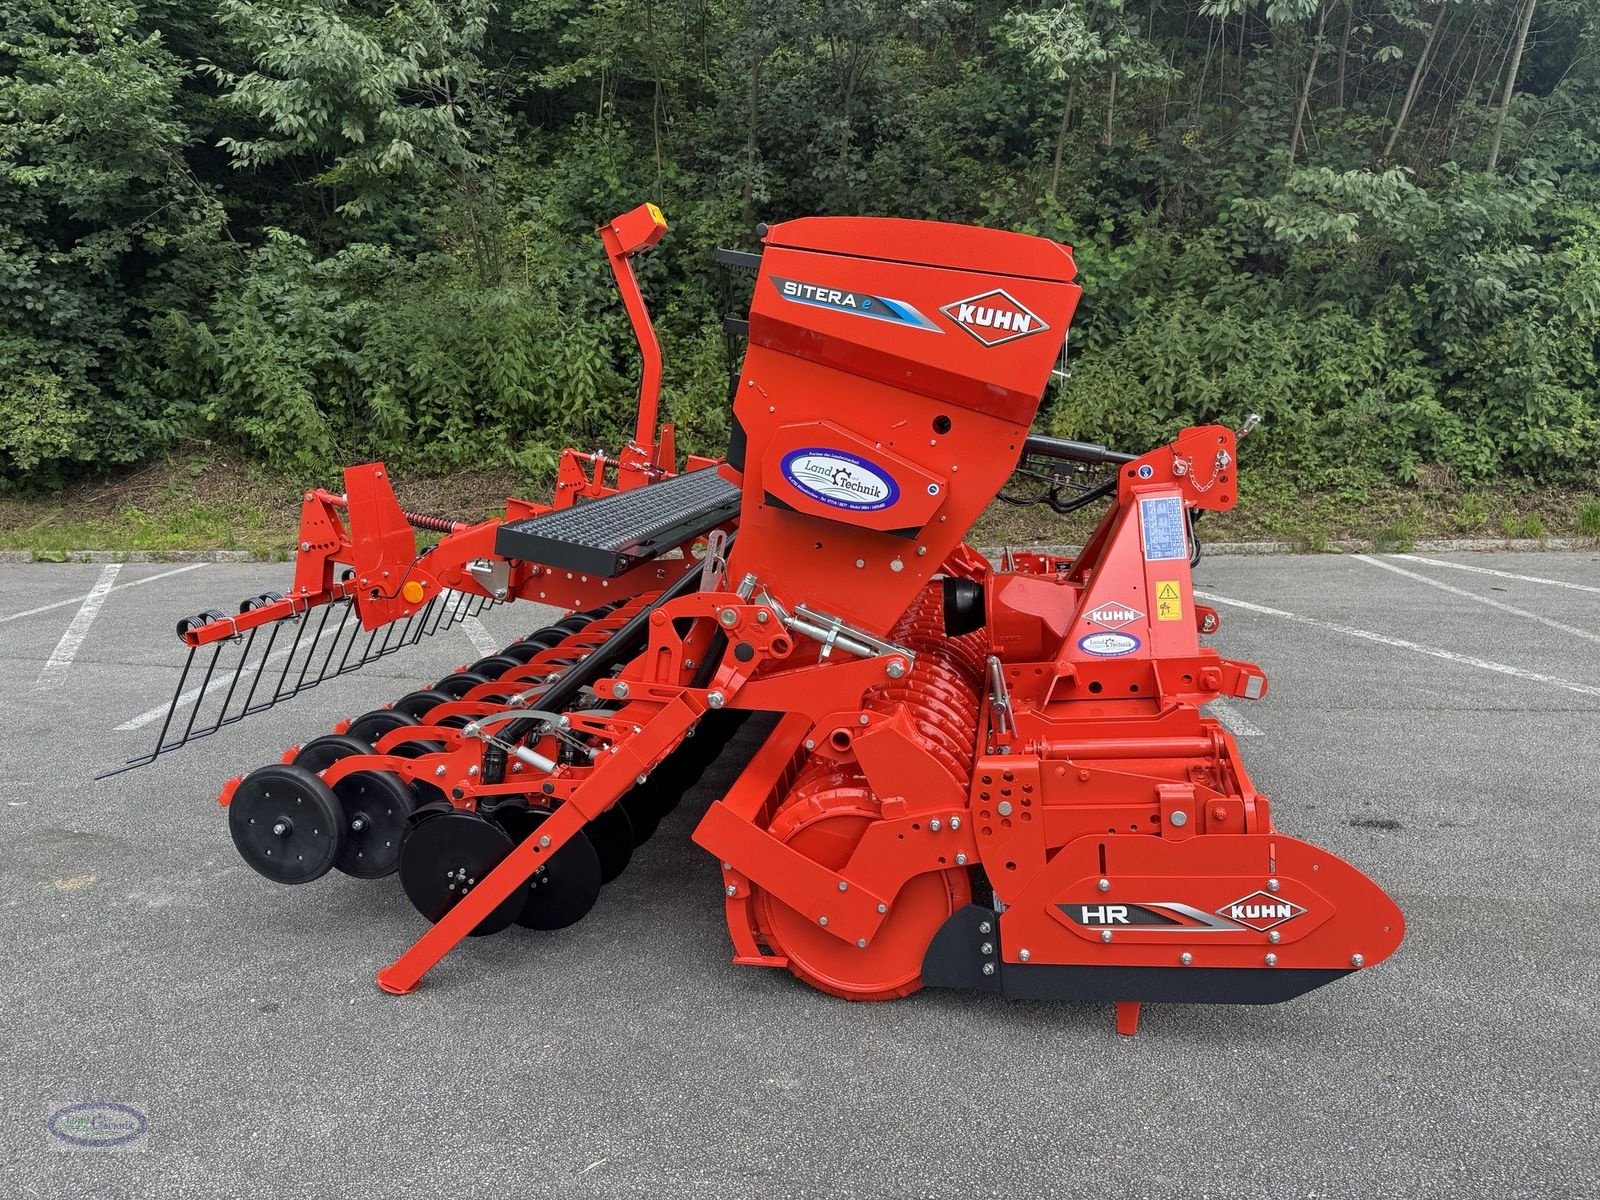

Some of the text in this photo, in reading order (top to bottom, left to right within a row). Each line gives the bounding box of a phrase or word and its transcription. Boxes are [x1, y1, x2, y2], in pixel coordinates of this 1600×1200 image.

[783, 281, 872, 310] SITERA e
[958, 303, 1032, 333] KUHN
[805, 460, 833, 477] Land
[840, 477, 881, 498] Technik
[1093, 611, 1134, 621] KUHN
[1081, 905, 1131, 924] HR
[1231, 905, 1291, 919] KUHN
